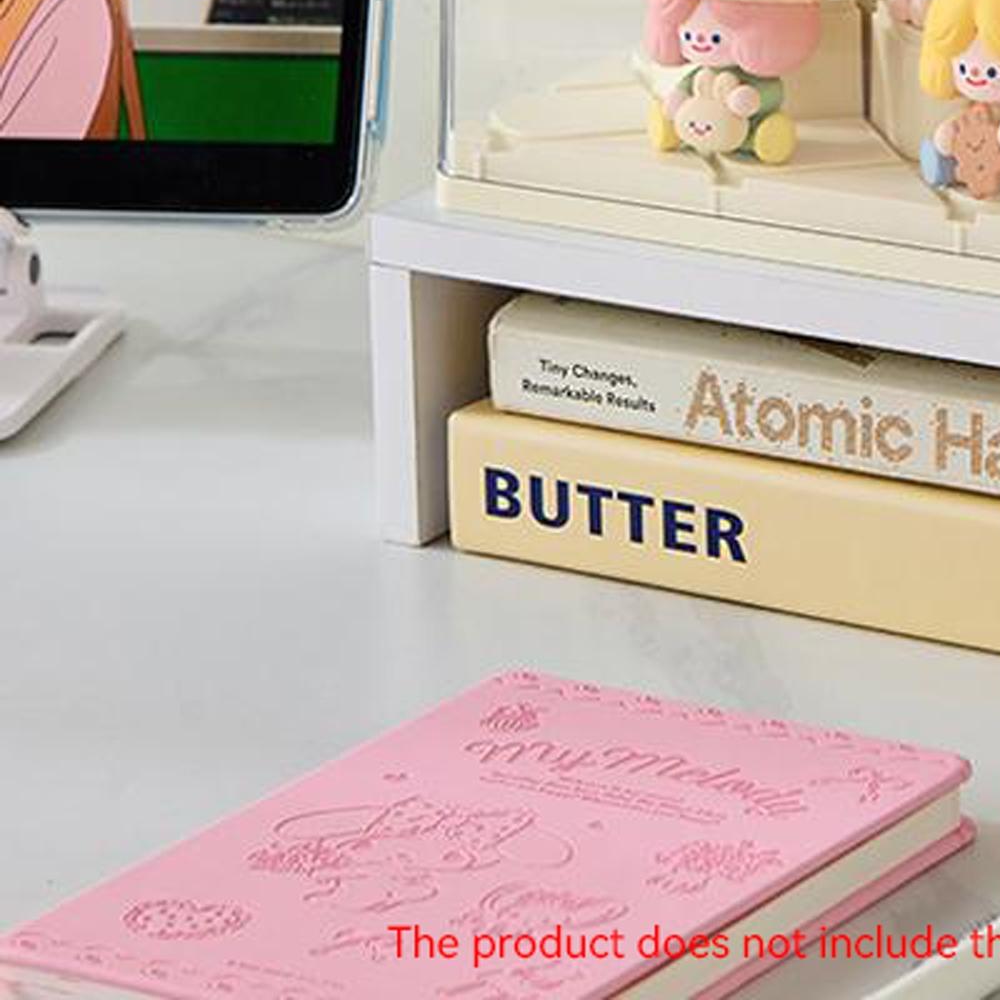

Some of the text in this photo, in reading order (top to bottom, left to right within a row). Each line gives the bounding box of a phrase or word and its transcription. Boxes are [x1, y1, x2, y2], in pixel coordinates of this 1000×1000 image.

[521, 378, 656, 413] Remarkable Results
[539, 358, 638, 388] Tiny Changes,
[684, 369, 914, 464] Atomic
[483, 466, 748, 564] BUTTER
